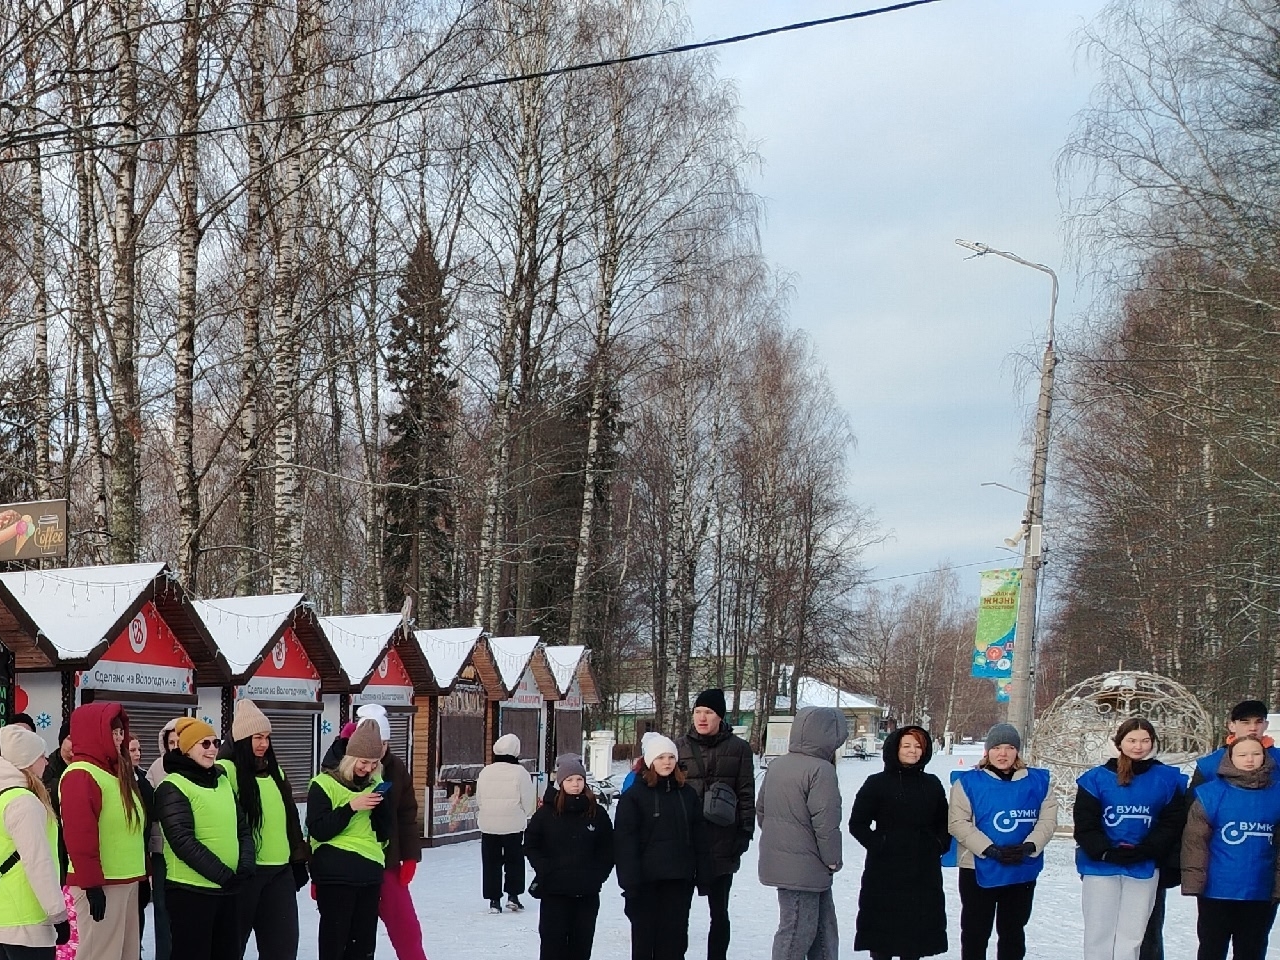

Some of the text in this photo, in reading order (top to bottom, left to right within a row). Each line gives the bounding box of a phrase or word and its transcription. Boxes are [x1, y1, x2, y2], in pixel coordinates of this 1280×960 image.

[34, 526, 64, 549] Coffee
[983, 597, 1015, 605] ЖИЗНЬ
[94, 670, 177, 687] Сделано на Вологодчине
[247, 685, 269, 695] Сделано
[1009, 809, 1037, 818] ВУМК
[1116, 805, 1150, 814] ВУМК
[1239, 821, 1274, 832] ВУМК
